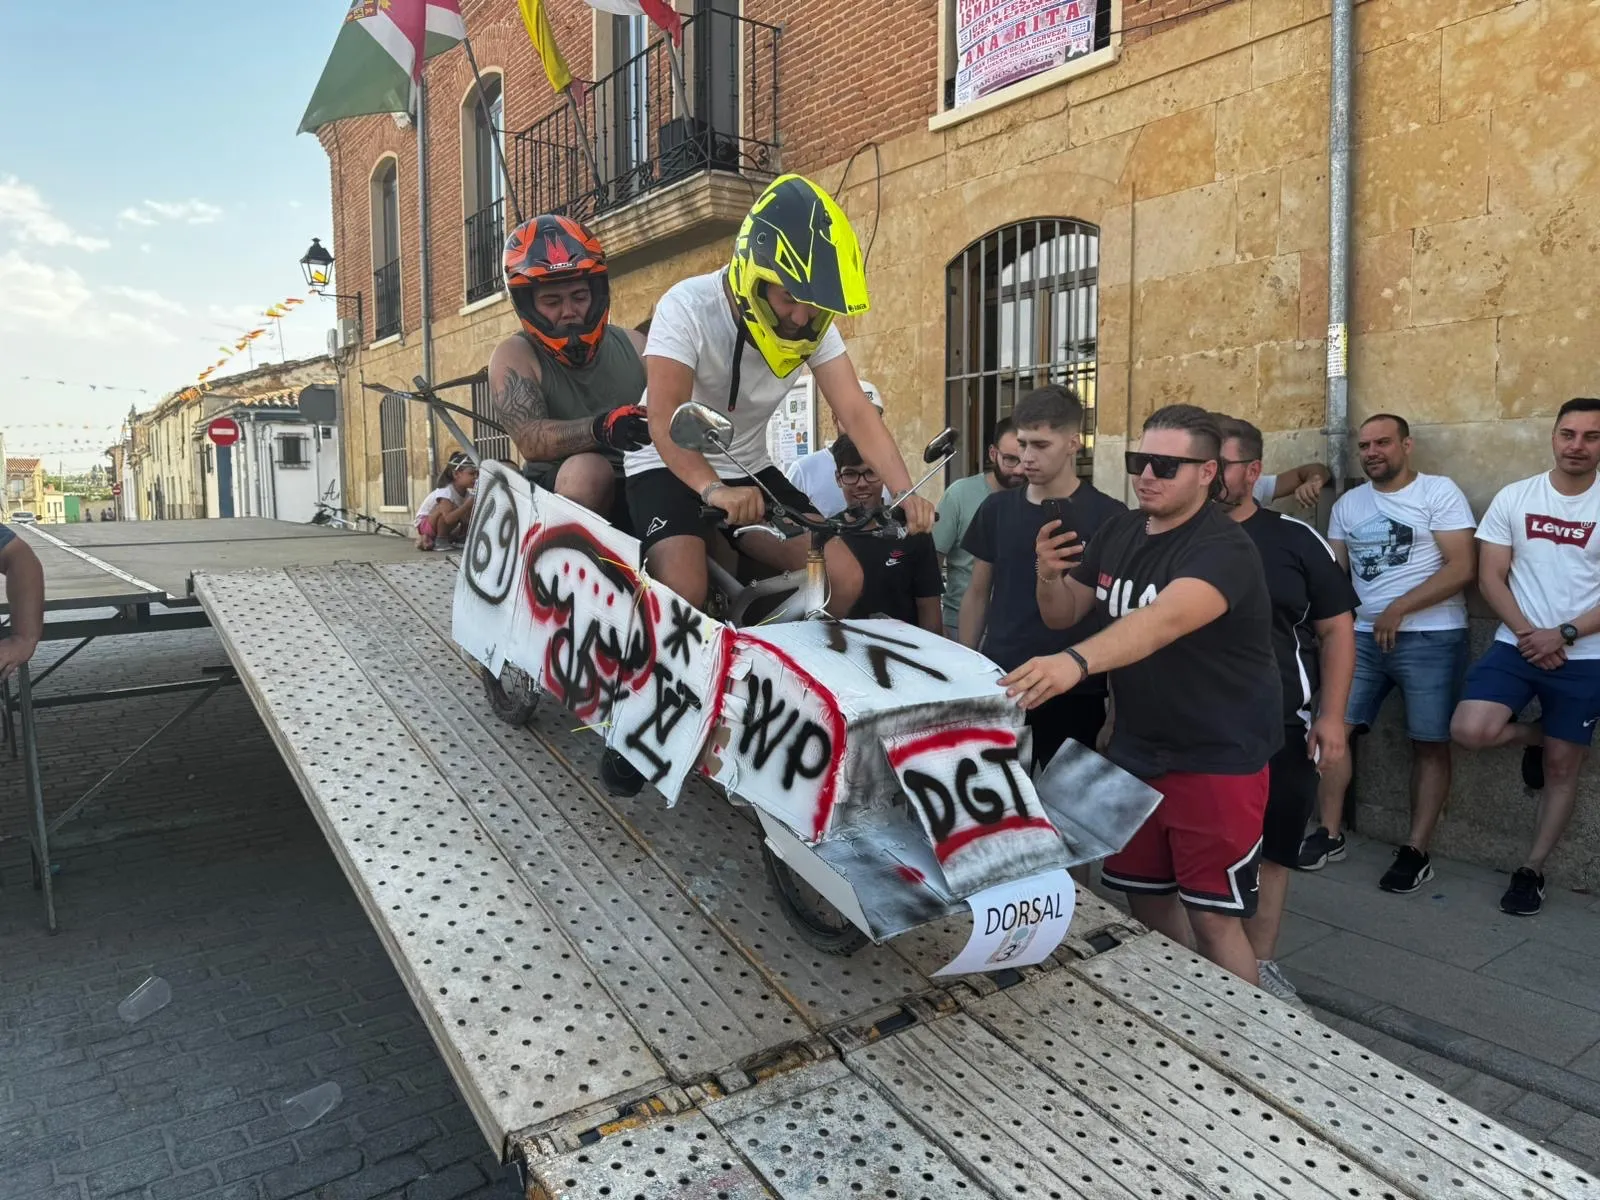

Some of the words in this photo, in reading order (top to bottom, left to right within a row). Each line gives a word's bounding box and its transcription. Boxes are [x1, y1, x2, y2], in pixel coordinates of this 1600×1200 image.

[965, 34, 999, 67] ANA
[1015, 2, 1080, 39] RITA
[1020, 40, 1030, 48] LA
[1032, 27, 1067, 44] CERVEZA
[1021, 35, 1066, 52] VAQUILLAS
[1020, 50, 1062, 68] NEGRA
[470, 497, 517, 588] 69
[738, 673, 832, 791] WP
[902, 746, 1033, 845] DGT
[984, 892, 1063, 936] DORSAL
[996, 944, 1018, 962] 3
